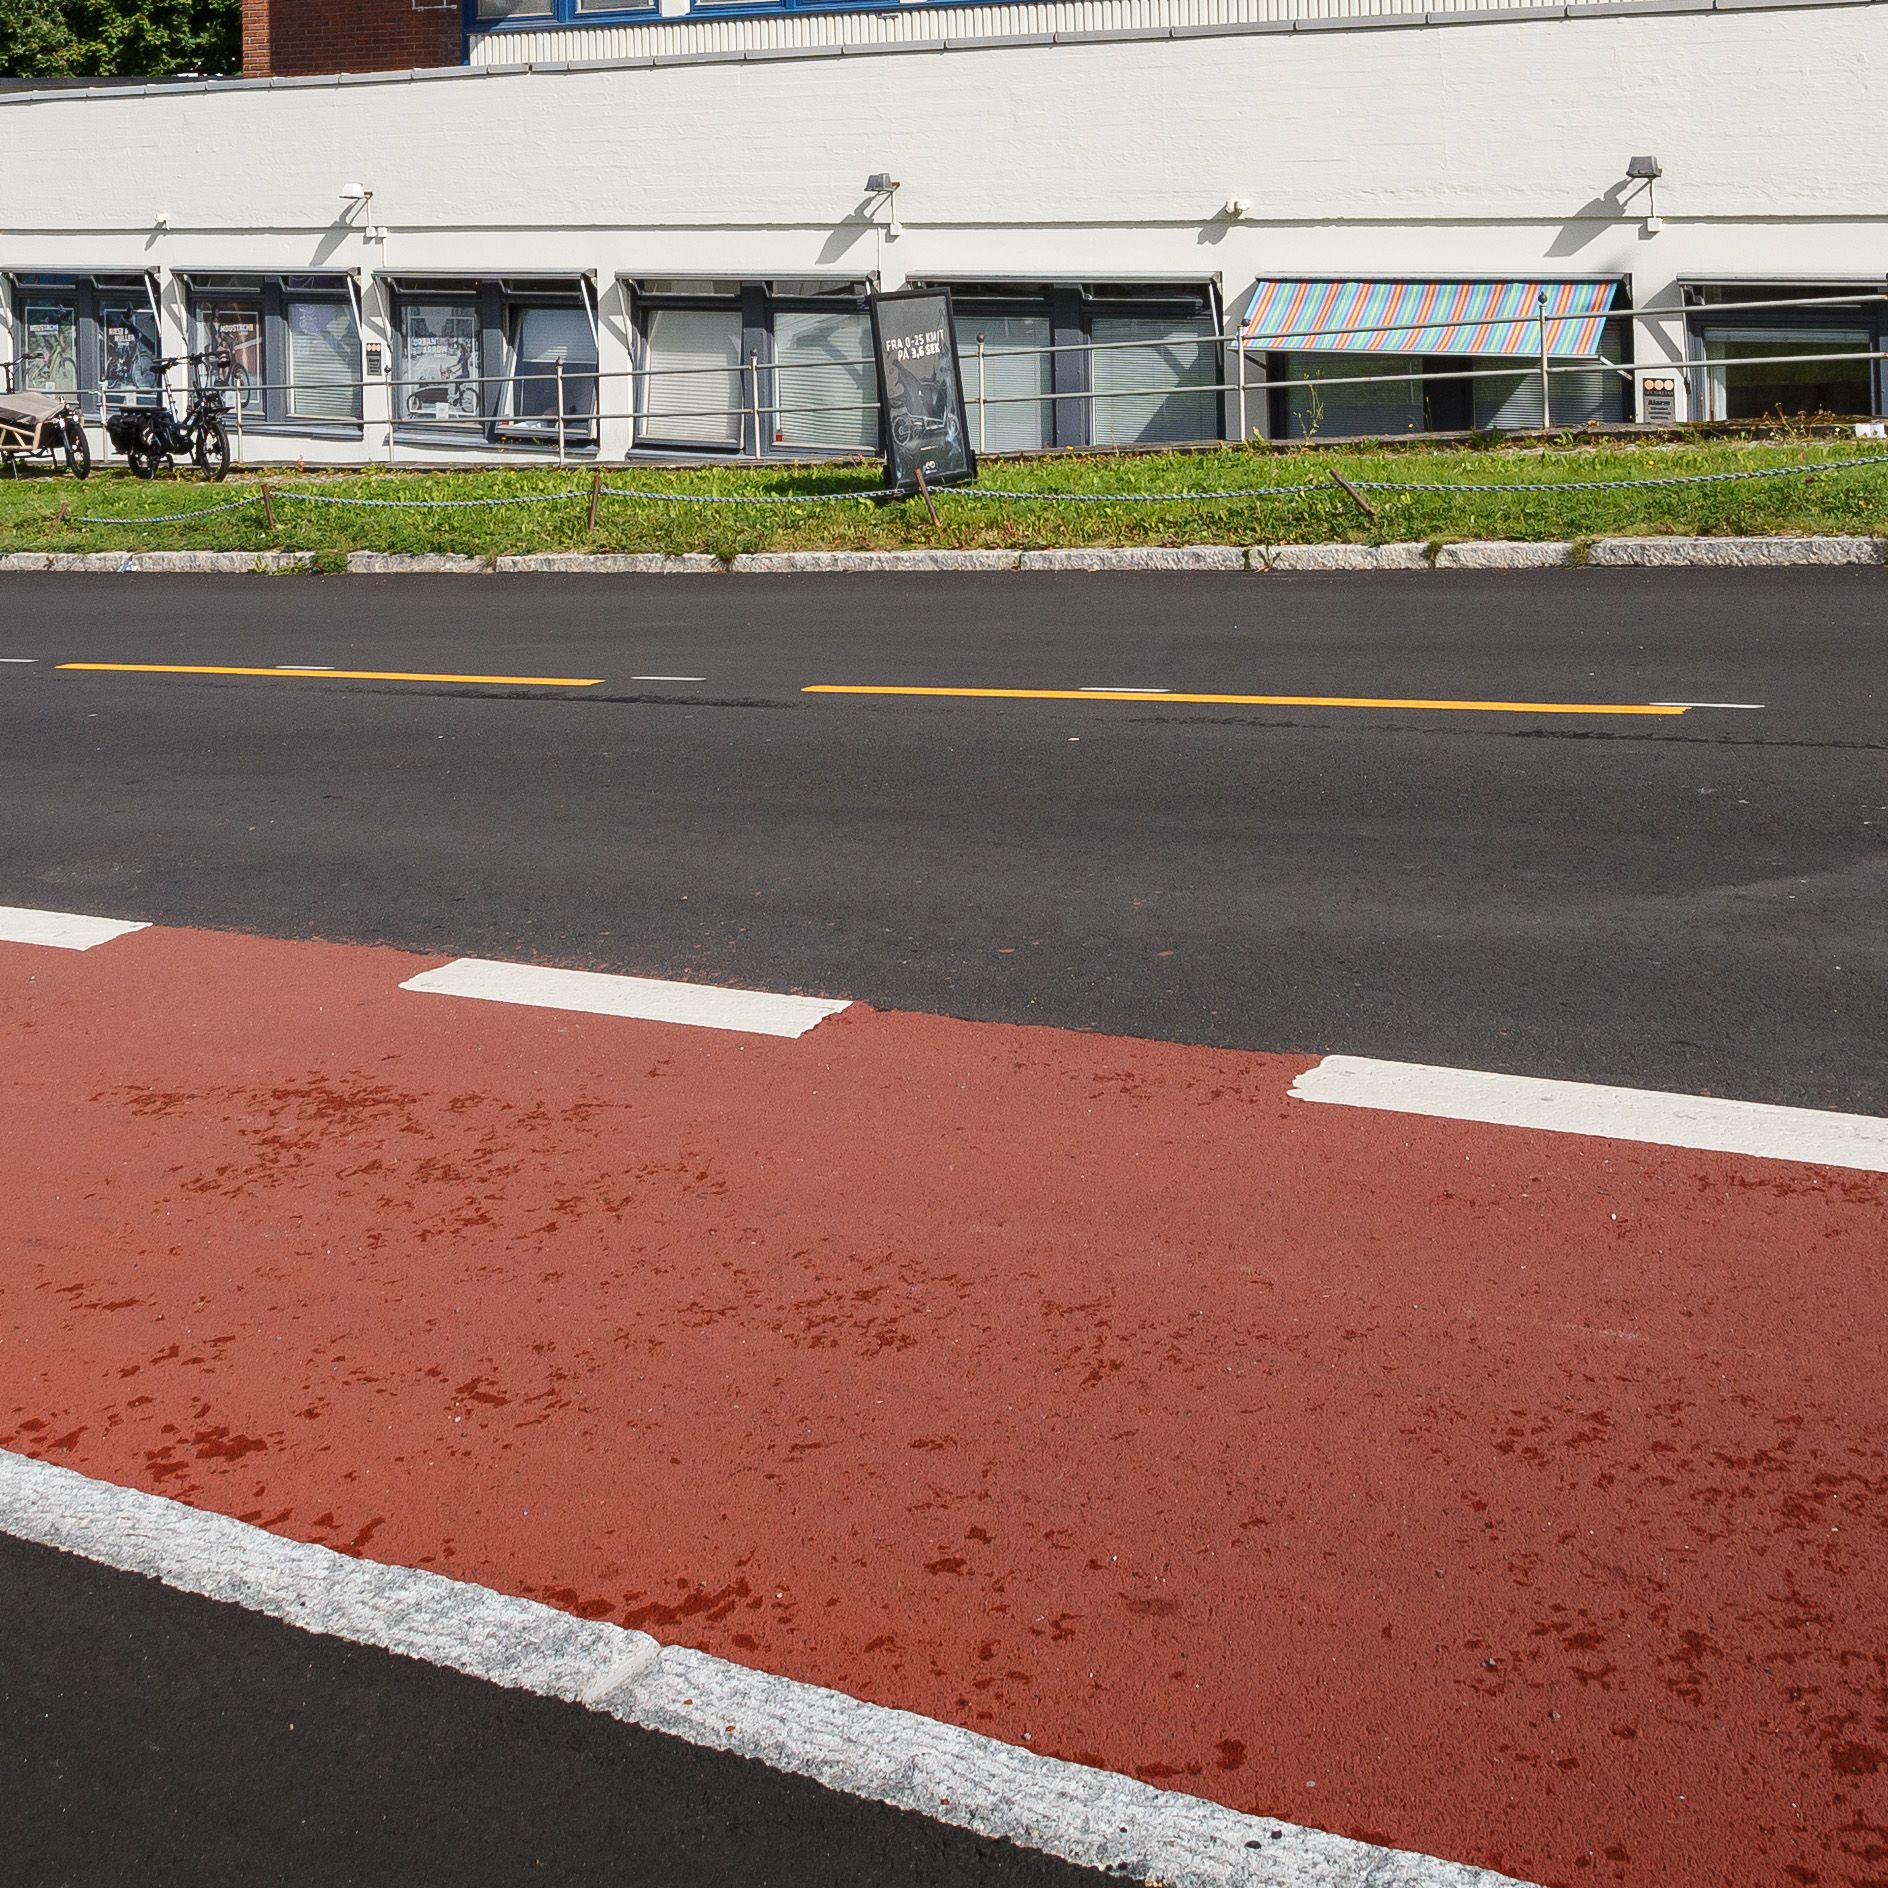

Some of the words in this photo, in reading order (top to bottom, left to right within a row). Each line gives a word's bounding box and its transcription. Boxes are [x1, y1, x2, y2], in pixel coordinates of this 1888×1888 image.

[886, 339, 903, 352] FRA
[904, 333, 924, 349] 0-25
[925, 329, 945, 345] KM/T
[897, 346, 910, 361] PÅ
[911, 345, 925, 360] 3,6
[925, 341, 941, 355] SEK
